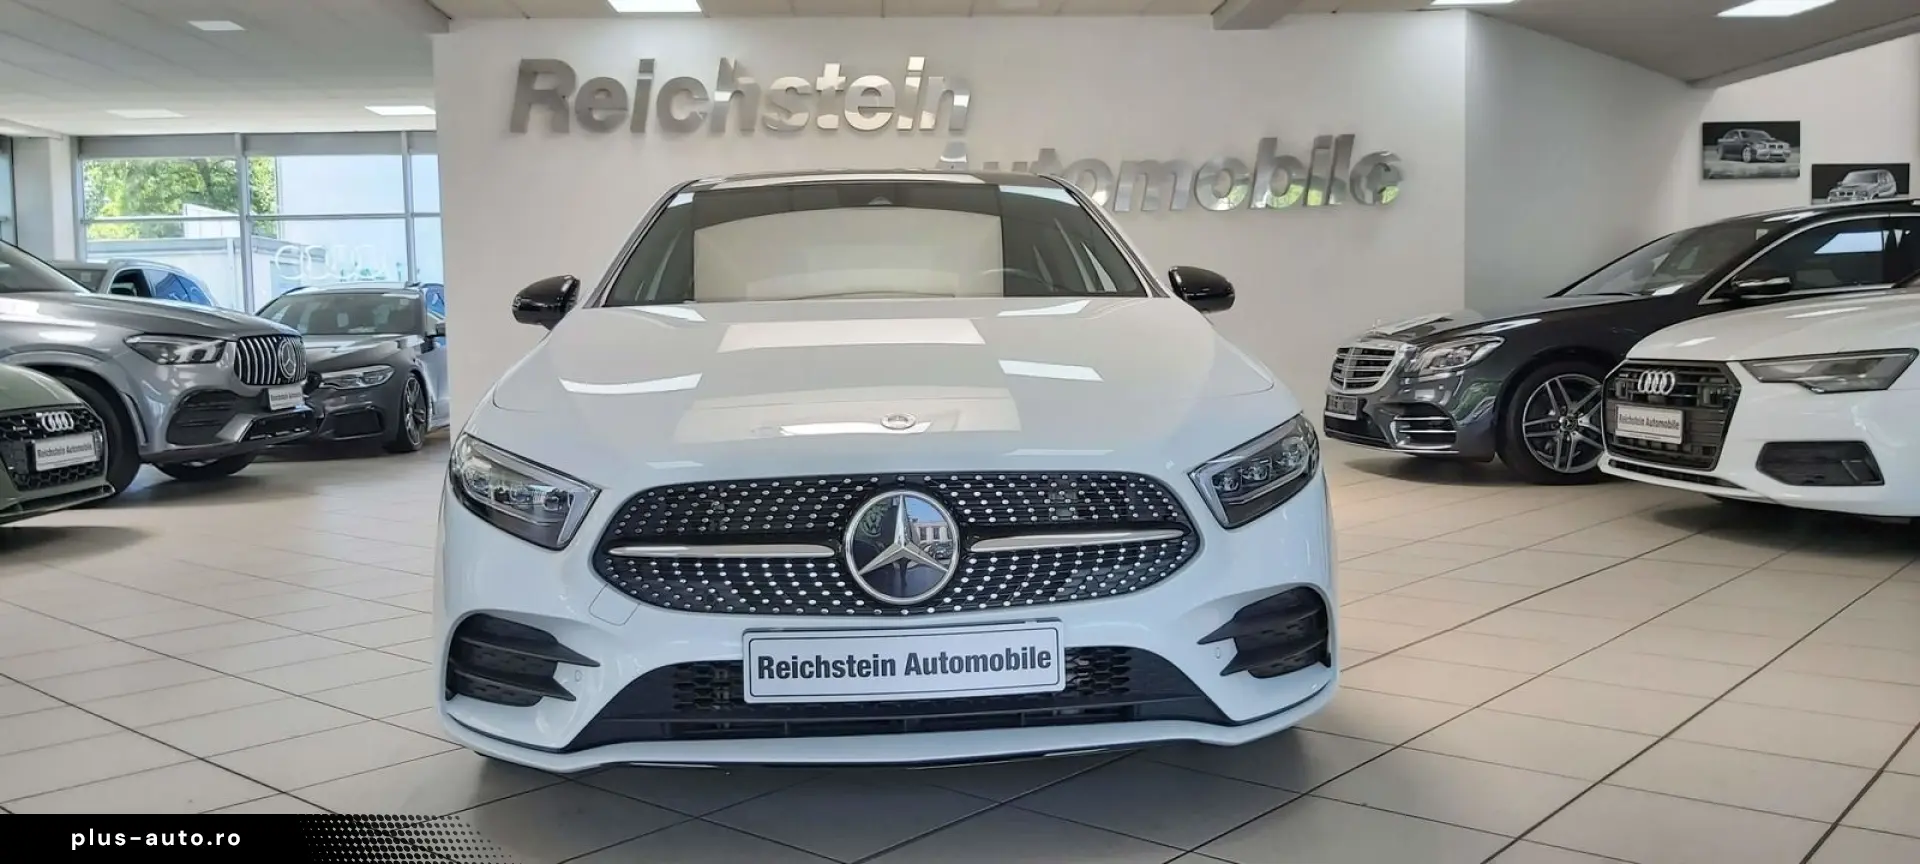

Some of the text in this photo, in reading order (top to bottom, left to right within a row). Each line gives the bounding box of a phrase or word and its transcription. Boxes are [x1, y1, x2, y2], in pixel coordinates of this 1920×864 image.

[510, 57, 971, 133] Reichstein
[936, 134, 1404, 212] omobile
[757, 646, 1052, 680] Reichstein Automobile
